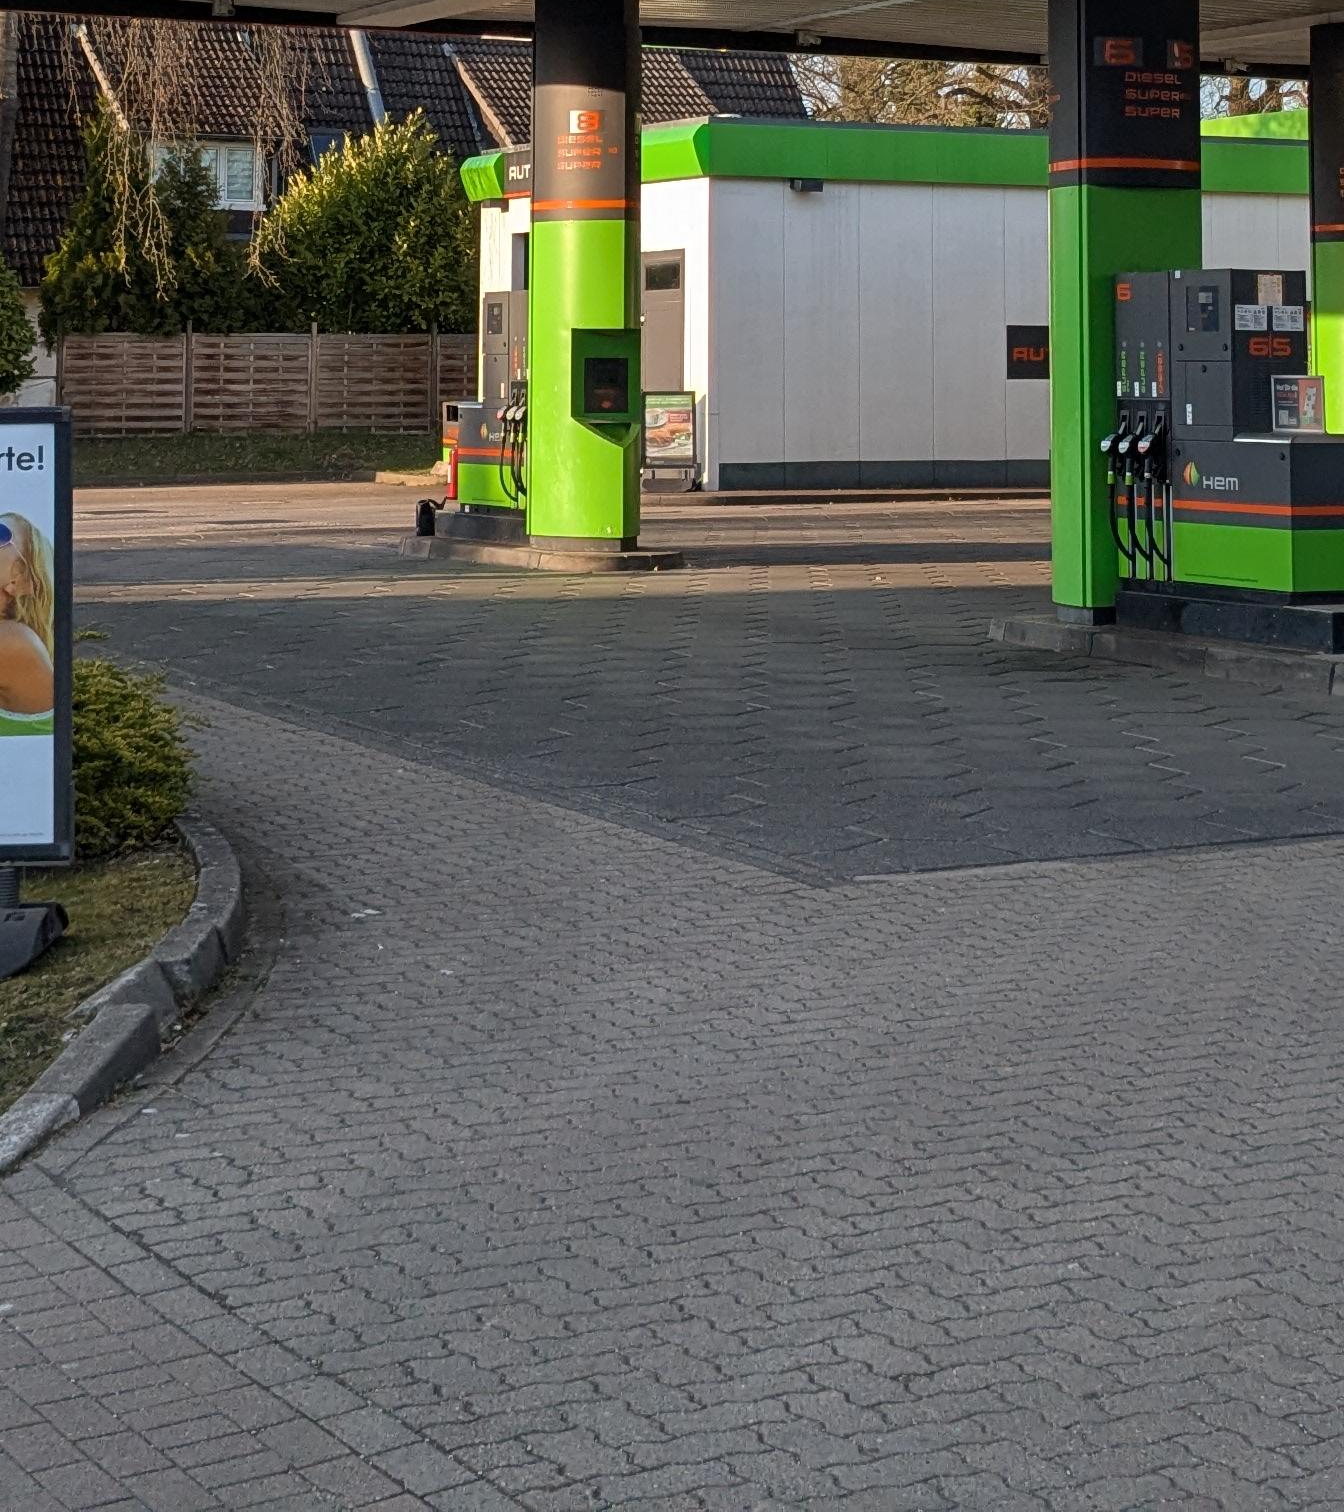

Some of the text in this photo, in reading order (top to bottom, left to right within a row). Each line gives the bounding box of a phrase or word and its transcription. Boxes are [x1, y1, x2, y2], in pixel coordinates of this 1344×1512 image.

[1124, 71, 1183, 85] DIESEL
[1124, 88, 1181, 102] SUPER
[1124, 105, 1181, 119] SUPER
[1013, 347, 1048, 361] AU
